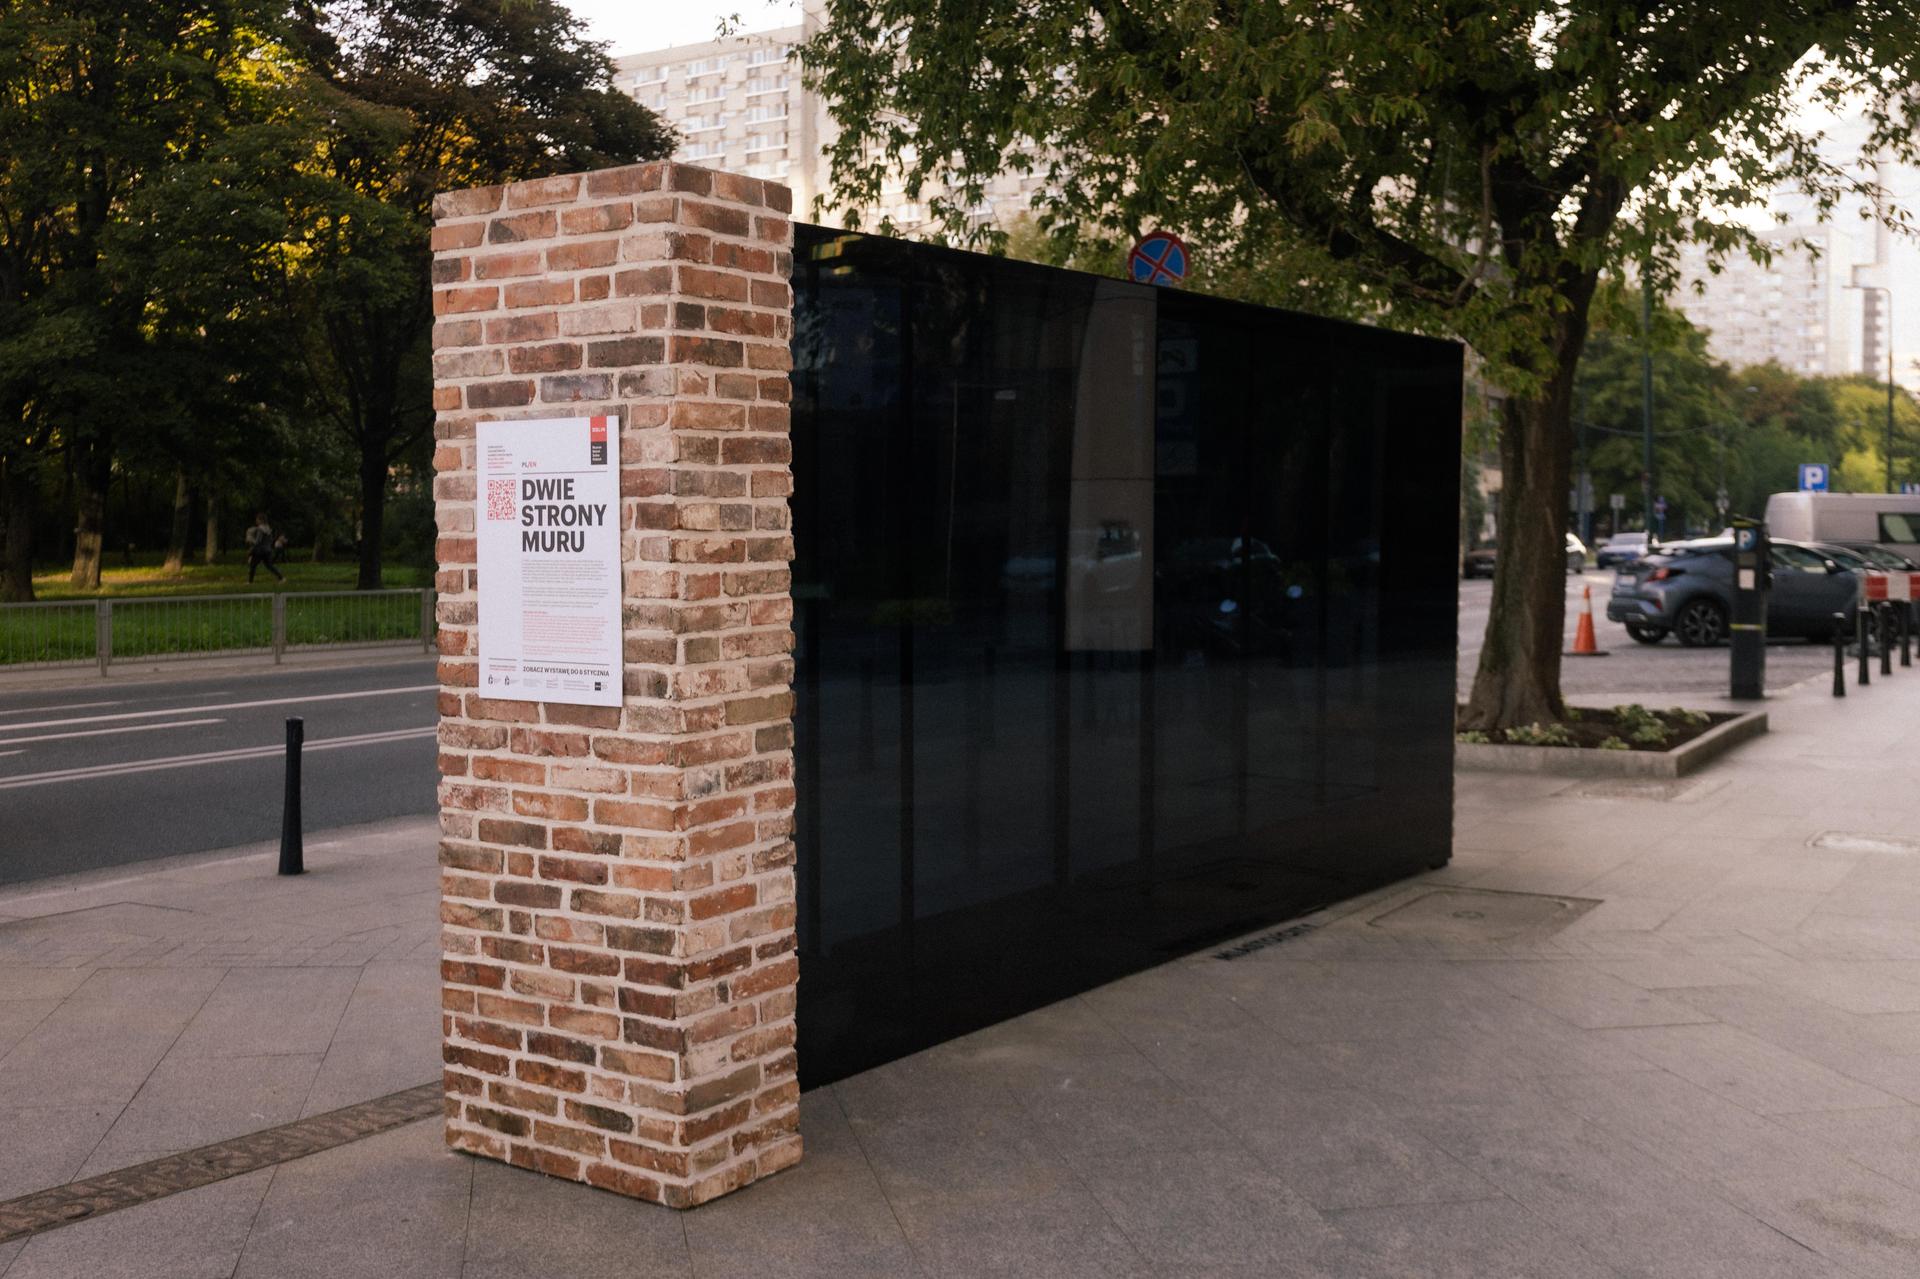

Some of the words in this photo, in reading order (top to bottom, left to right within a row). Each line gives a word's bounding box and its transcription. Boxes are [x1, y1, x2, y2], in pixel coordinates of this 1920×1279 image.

[522, 478, 575, 501] DWIE
[1805, 466, 1824, 490] P
[521, 504, 607, 527] STRONY
[522, 530, 585, 553] MURU
[1738, 529, 1753, 550] P
[544, 667, 570, 675] WYSTAWĘ
[583, 668, 610, 676] STYCZNIA
